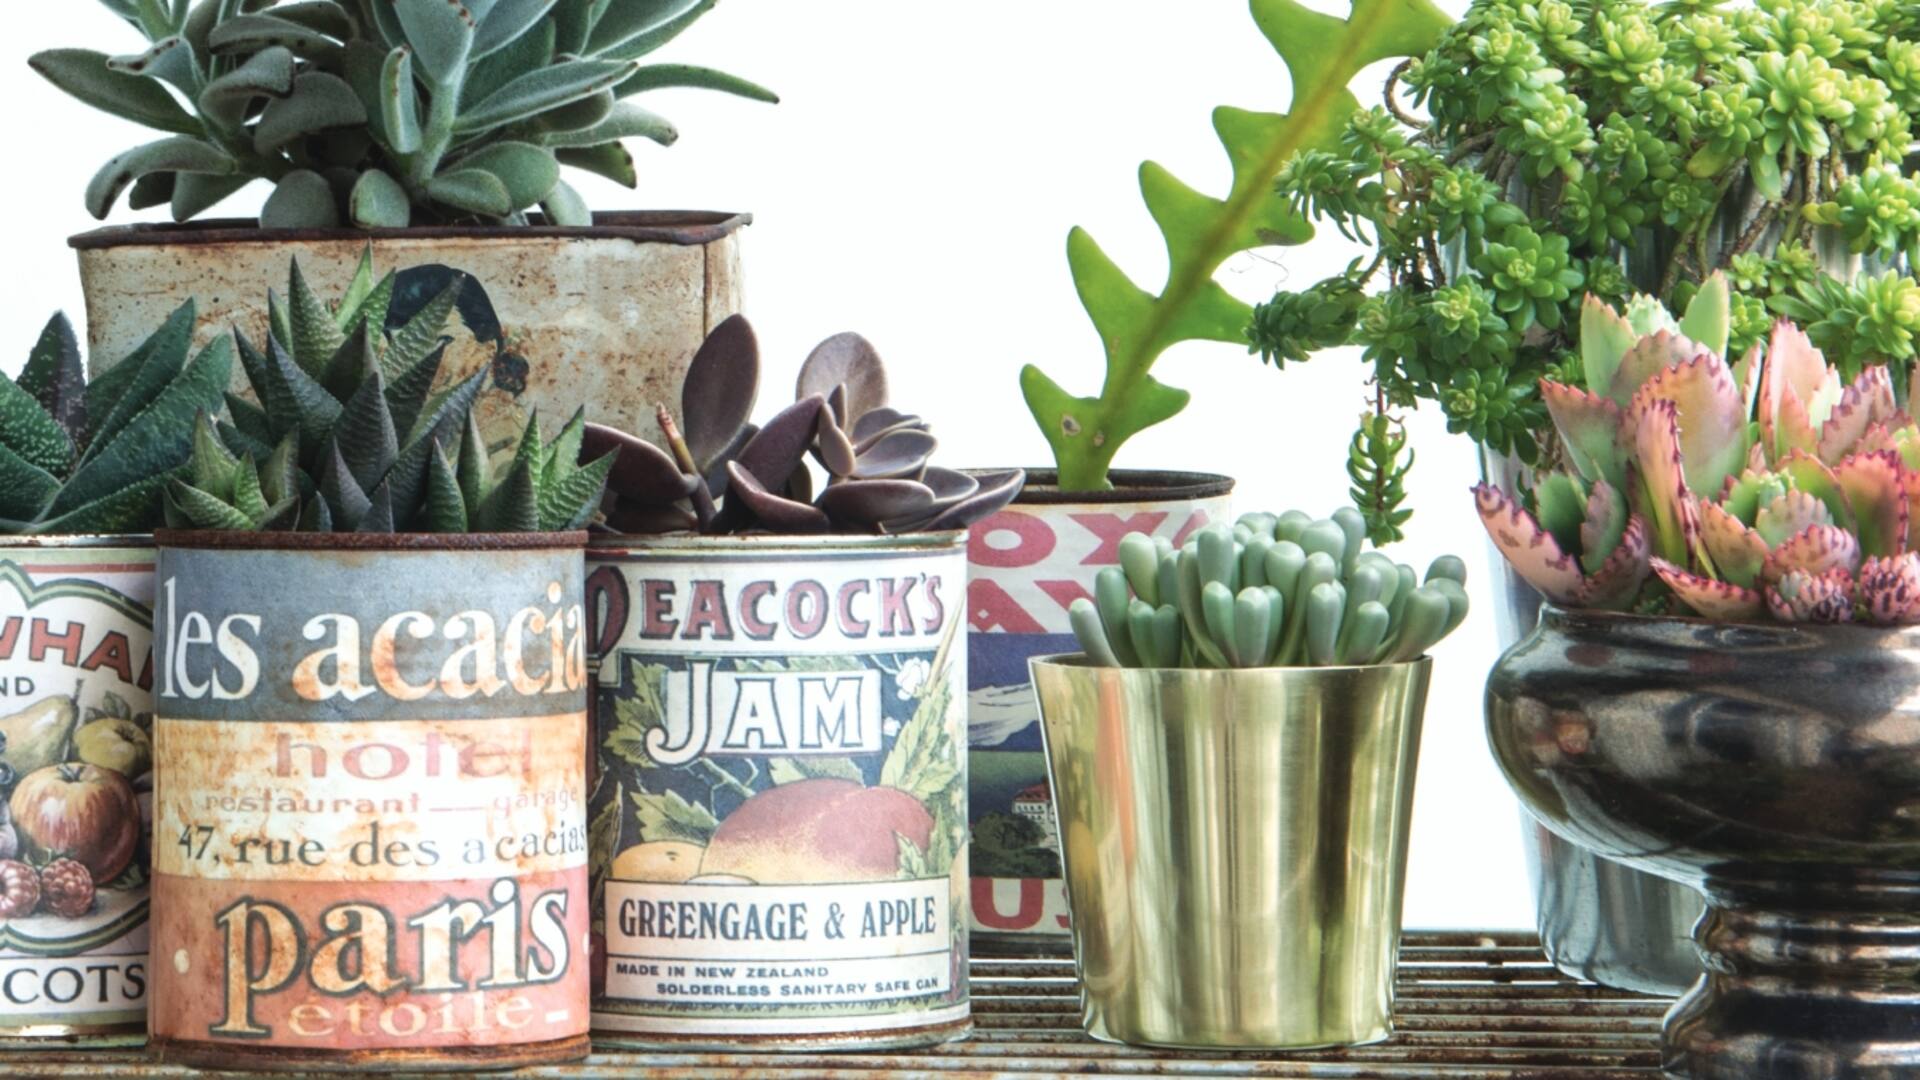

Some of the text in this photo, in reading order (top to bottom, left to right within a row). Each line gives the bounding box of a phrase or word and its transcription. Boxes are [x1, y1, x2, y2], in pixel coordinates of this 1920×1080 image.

[160, 575, 262, 700] les
[643, 657, 864, 766] JAM
[275, 728, 532, 781] hotel
[204, 785, 578, 819] restaurant garage
[234, 836, 327, 867] rue
[349, 819, 441, 868] des
[618, 895, 937, 942] GREENGAGE & APPLE
[208, 875, 572, 1038] paris
[616, 963, 829, 979] MADE IN NEW ZEALAND
[2, 962, 147, 1006] COTS
[656, 975, 938, 997] SOLDERLESS SANITARY SAFE CAN
